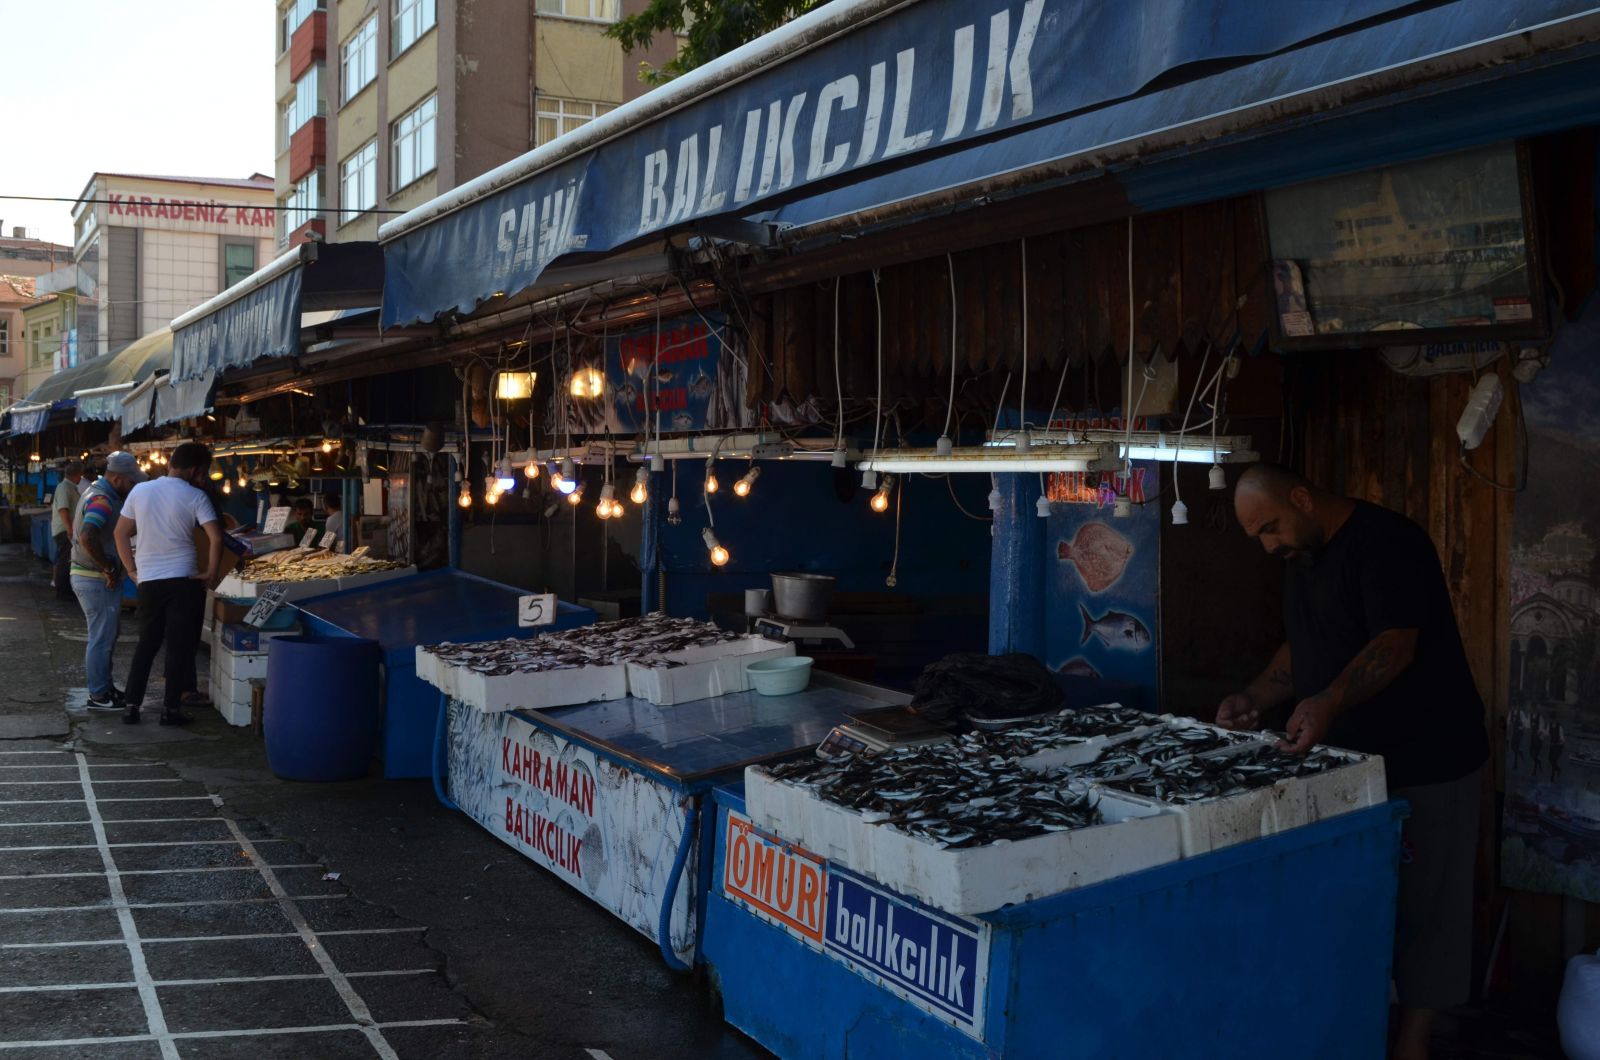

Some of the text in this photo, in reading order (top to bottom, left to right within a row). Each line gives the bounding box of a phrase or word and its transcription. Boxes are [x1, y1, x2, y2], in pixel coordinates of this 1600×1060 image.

[637, 0, 1045, 235] BALIKCILIK
[108, 194, 228, 223] KARADENİZ
[522, 598, 543, 622] 5
[502, 736, 595, 817] KAHRAMAN
[732, 823, 965, 1008] ÖMÜR balıkcılık
